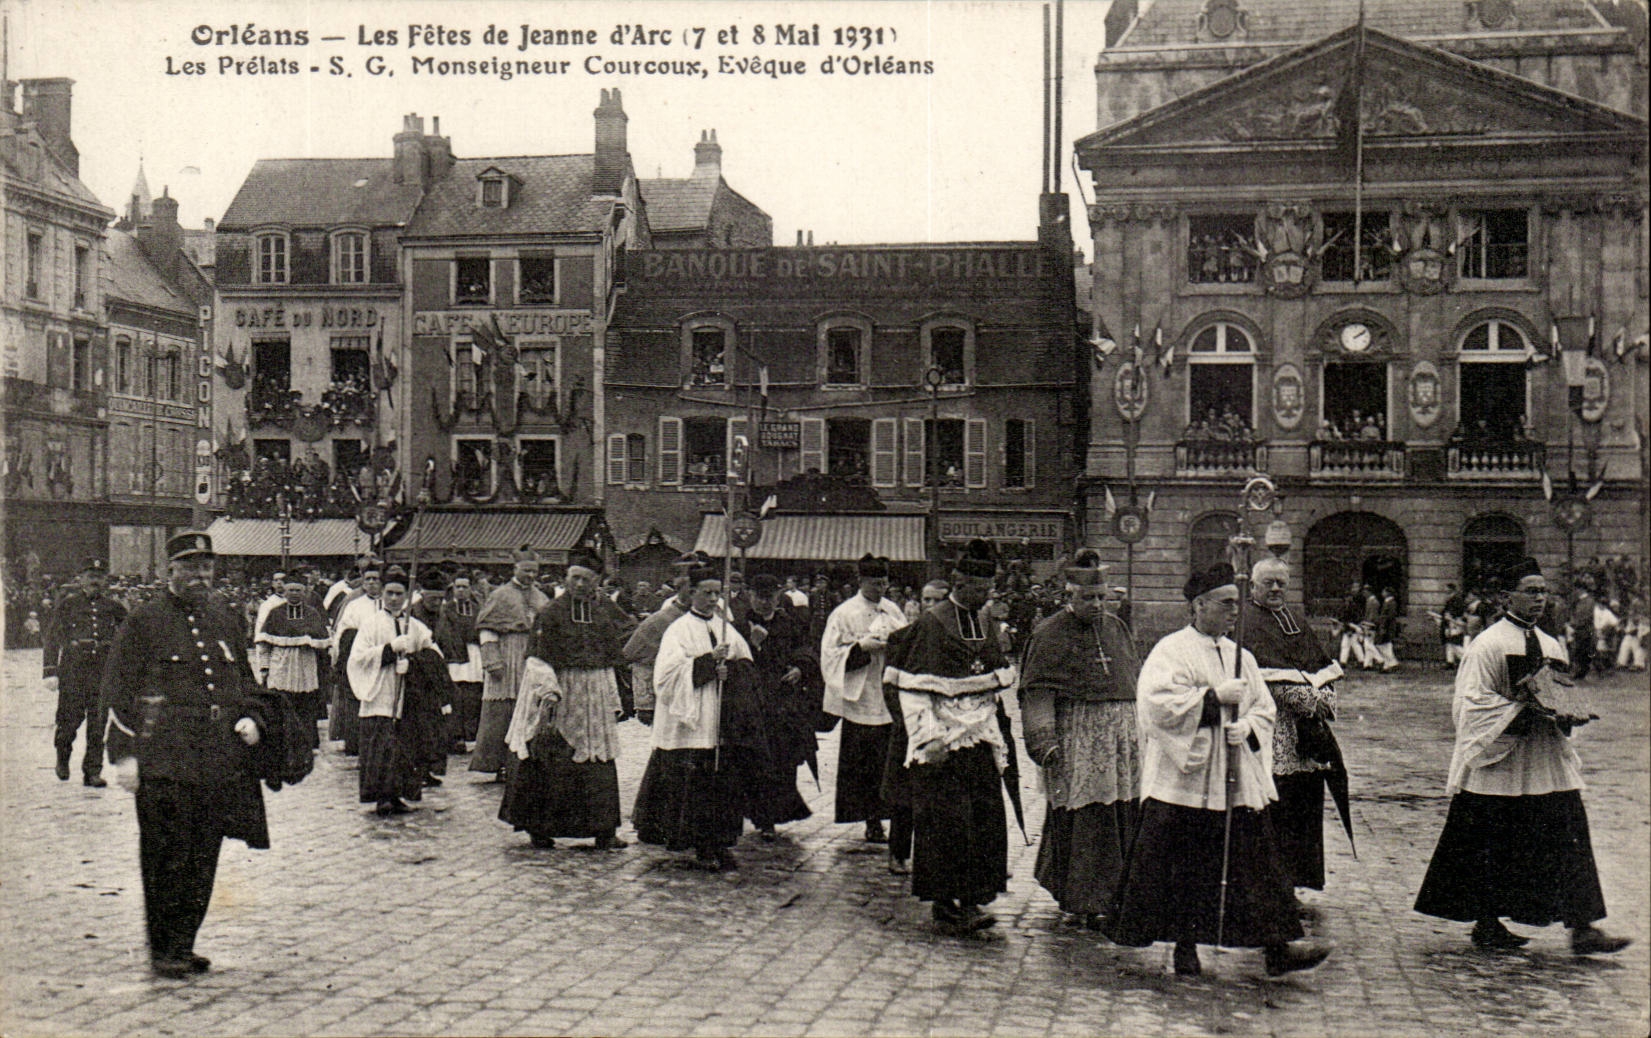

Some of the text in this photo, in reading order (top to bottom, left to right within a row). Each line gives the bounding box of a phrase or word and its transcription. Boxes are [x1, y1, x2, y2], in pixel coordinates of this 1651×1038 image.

[644, 252, 766, 279] BANQUE
[818, 252, 1050, 278] SAINT-PHALLE
[235, 303, 377, 328] CAFÉ DU NORD
[199, 305, 212, 429] PICON
[943, 523, 1057, 537] BOULANGERIE
